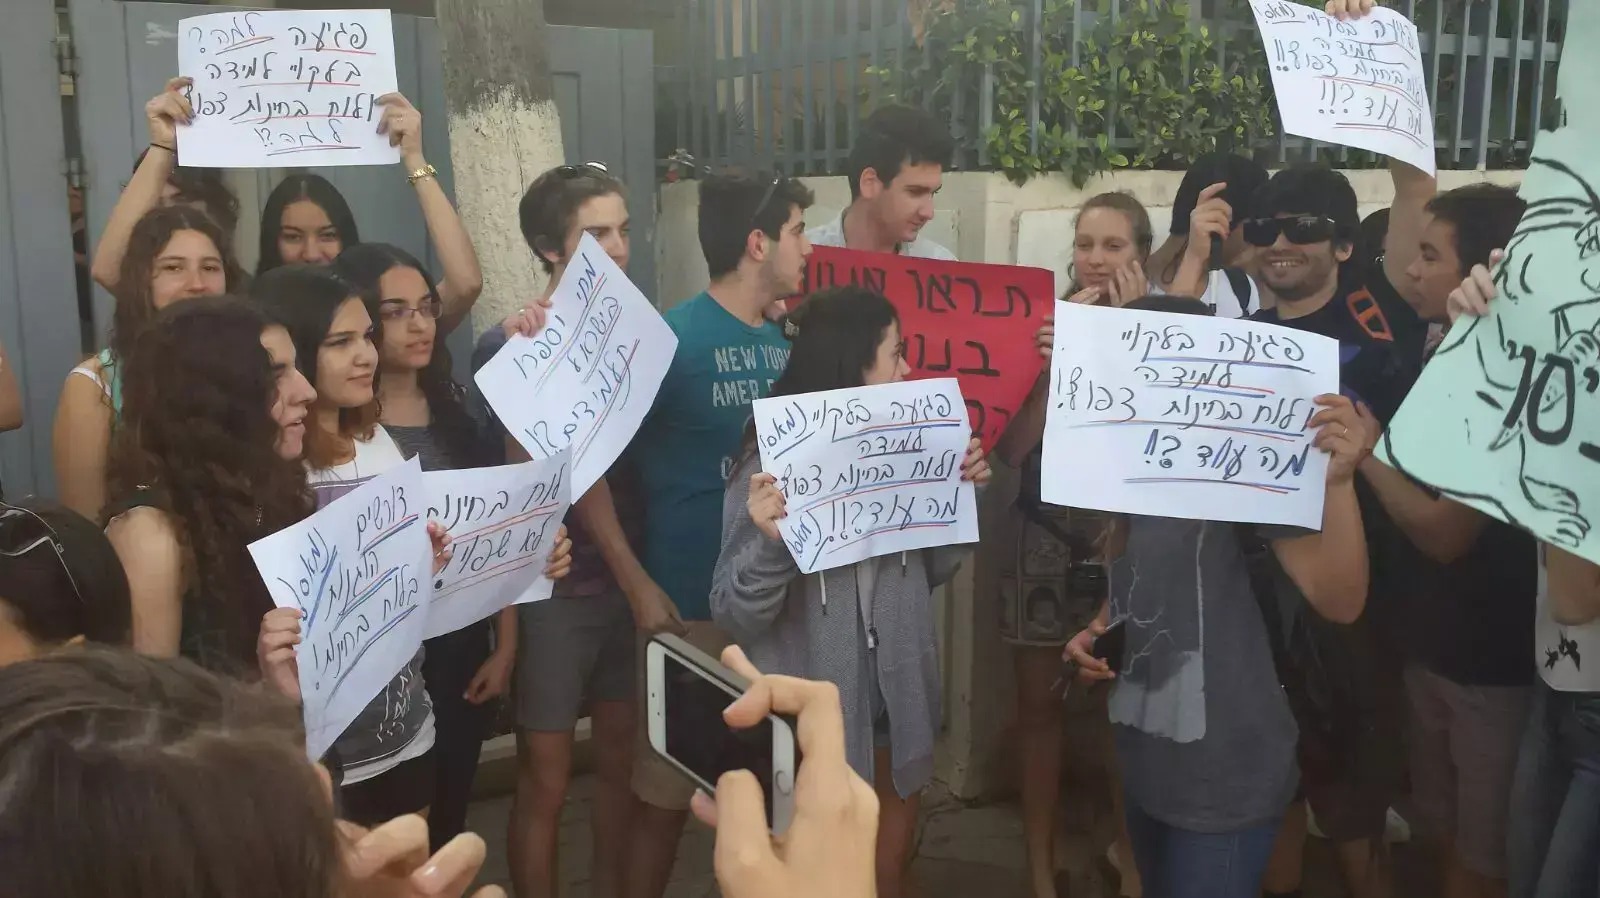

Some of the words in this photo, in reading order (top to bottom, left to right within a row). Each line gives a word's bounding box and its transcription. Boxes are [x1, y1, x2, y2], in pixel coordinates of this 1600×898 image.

[288, 22, 367, 51] פגיעה
[205, 52, 277, 80] למידה
[289, 57, 361, 92] בלקויי
[229, 92, 309, 124] בחינות
[906, 269, 1031, 317] תראו
[1122, 322, 1195, 362] בלקויי
[1218, 331, 1304, 362] פגיעה
[714, 345, 757, 373] NEW
[1134, 362, 1232, 388] למידה
[891, 393, 951, 424] פגיעה
[1161, 395, 1243, 430] בחינות
[858, 427, 929, 454] למידה
[1258, 444, 1309, 480] מה
[830, 463, 895, 494] בחינות
[926, 487, 959, 519] מה
